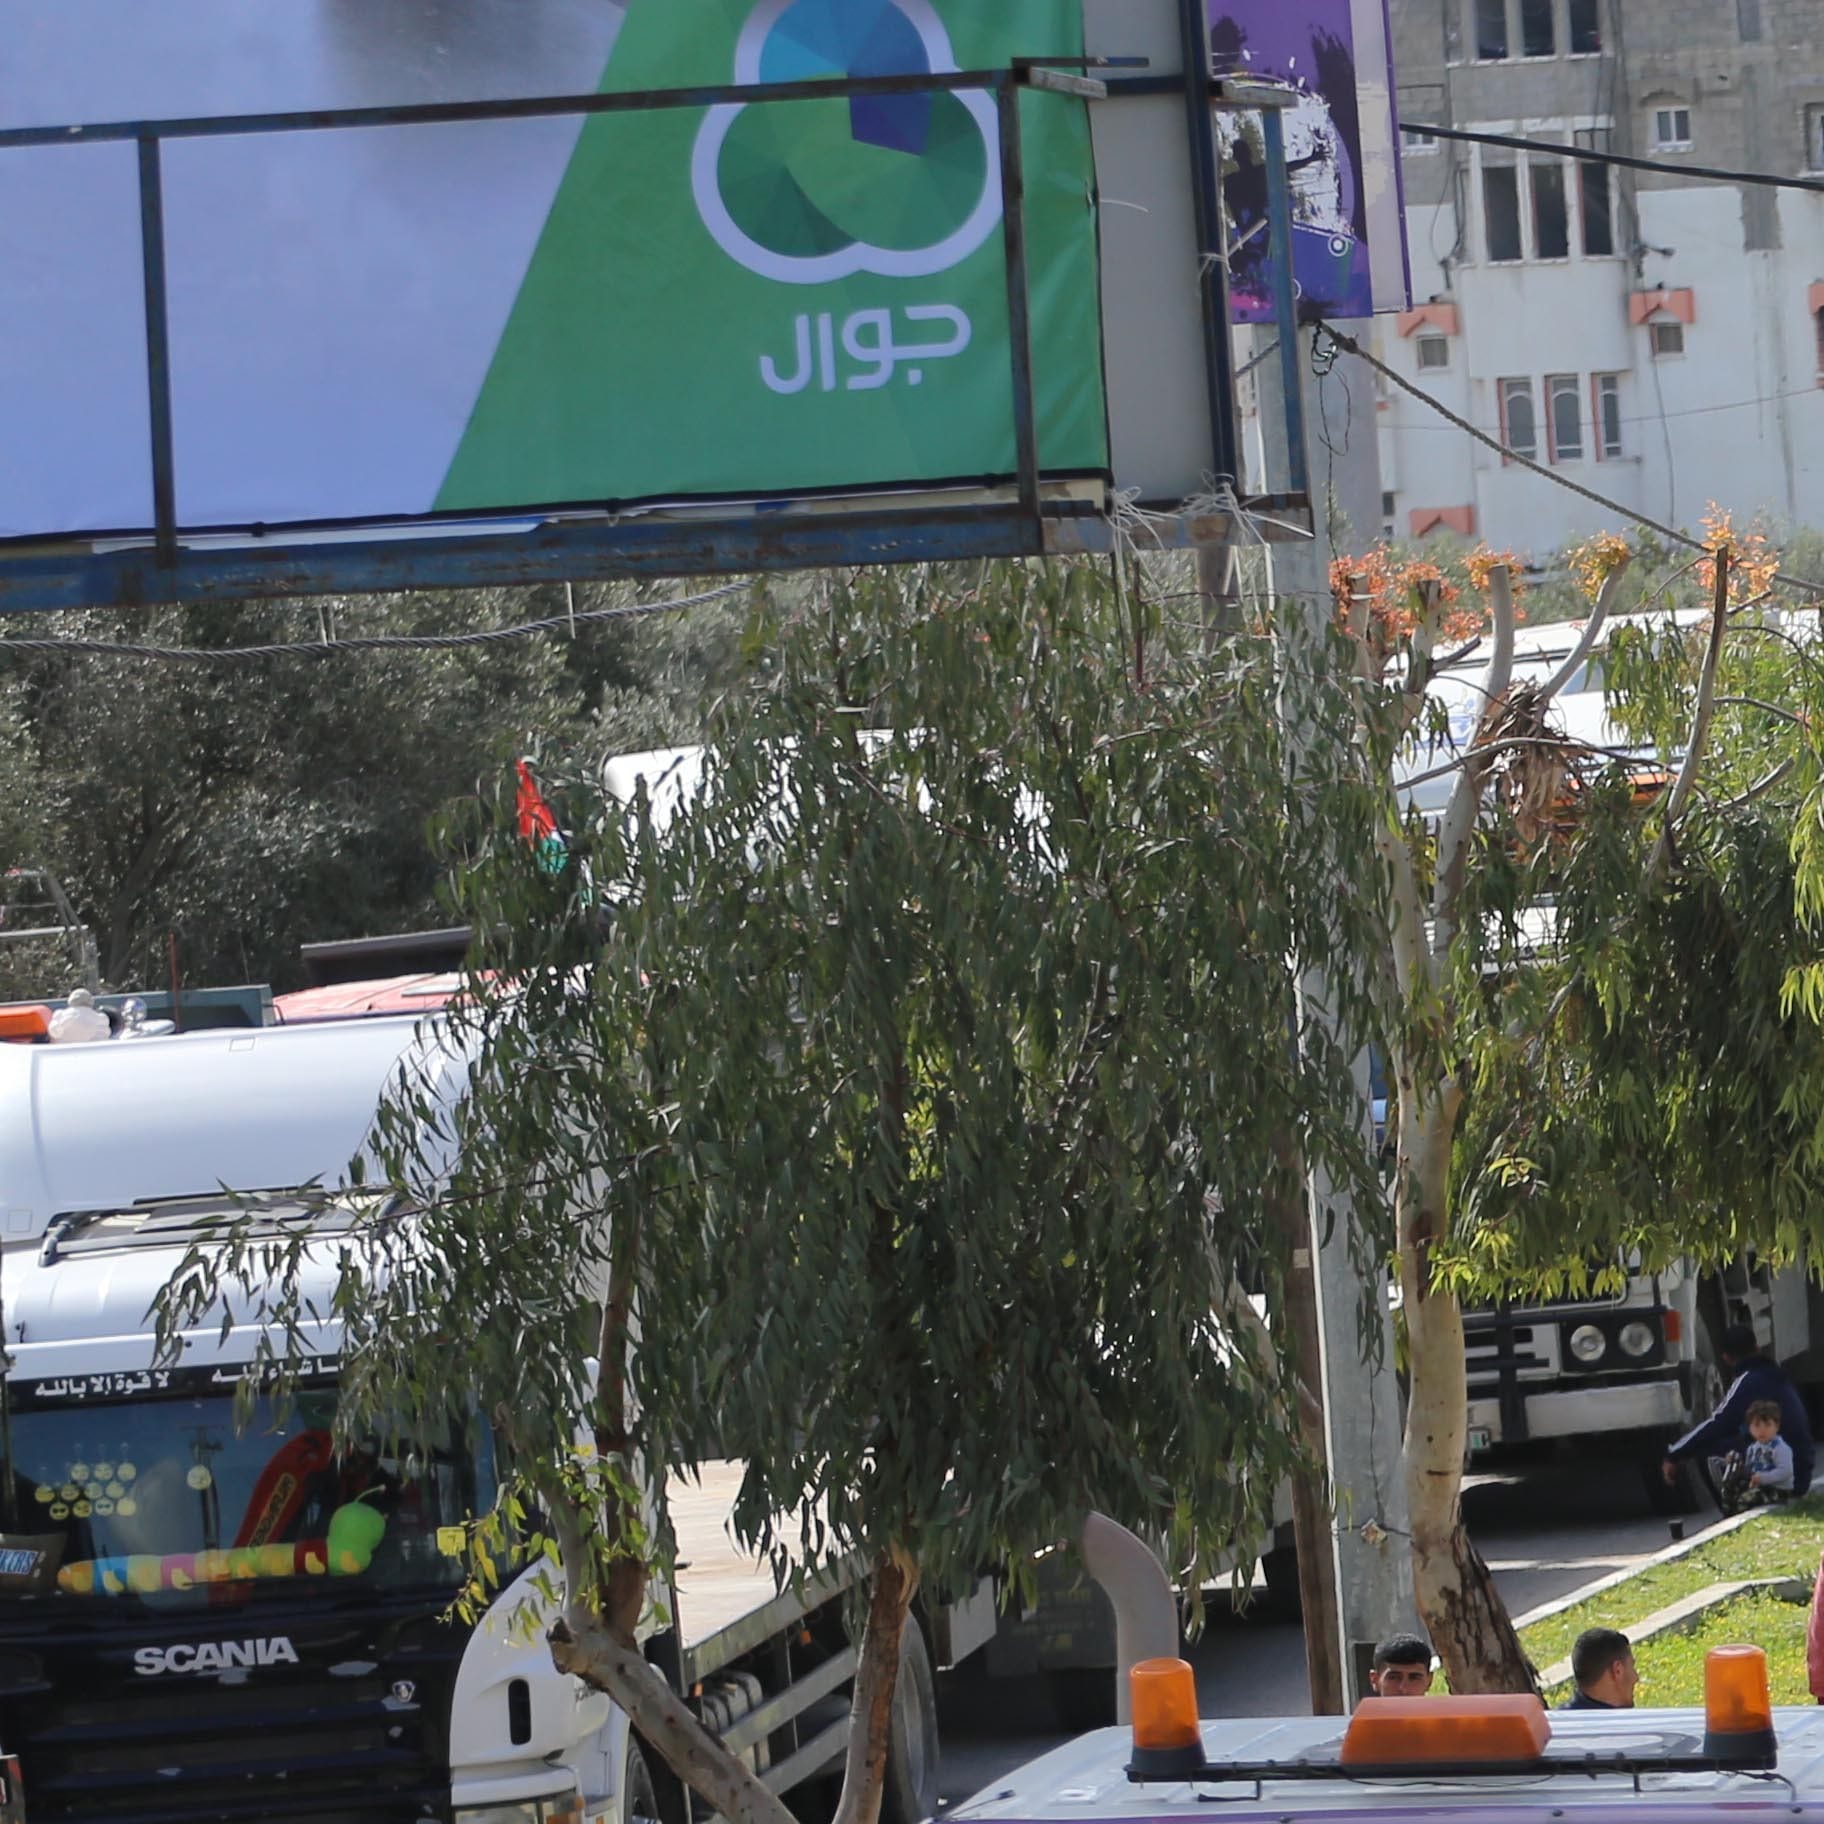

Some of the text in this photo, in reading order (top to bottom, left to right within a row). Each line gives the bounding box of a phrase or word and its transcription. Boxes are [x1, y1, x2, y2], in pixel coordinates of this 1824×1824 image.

[759, 301, 972, 396] جوال
[35, 1370, 170, 1398] لا قوة إلا بالله
[133, 1637, 300, 1675] SCANIA
